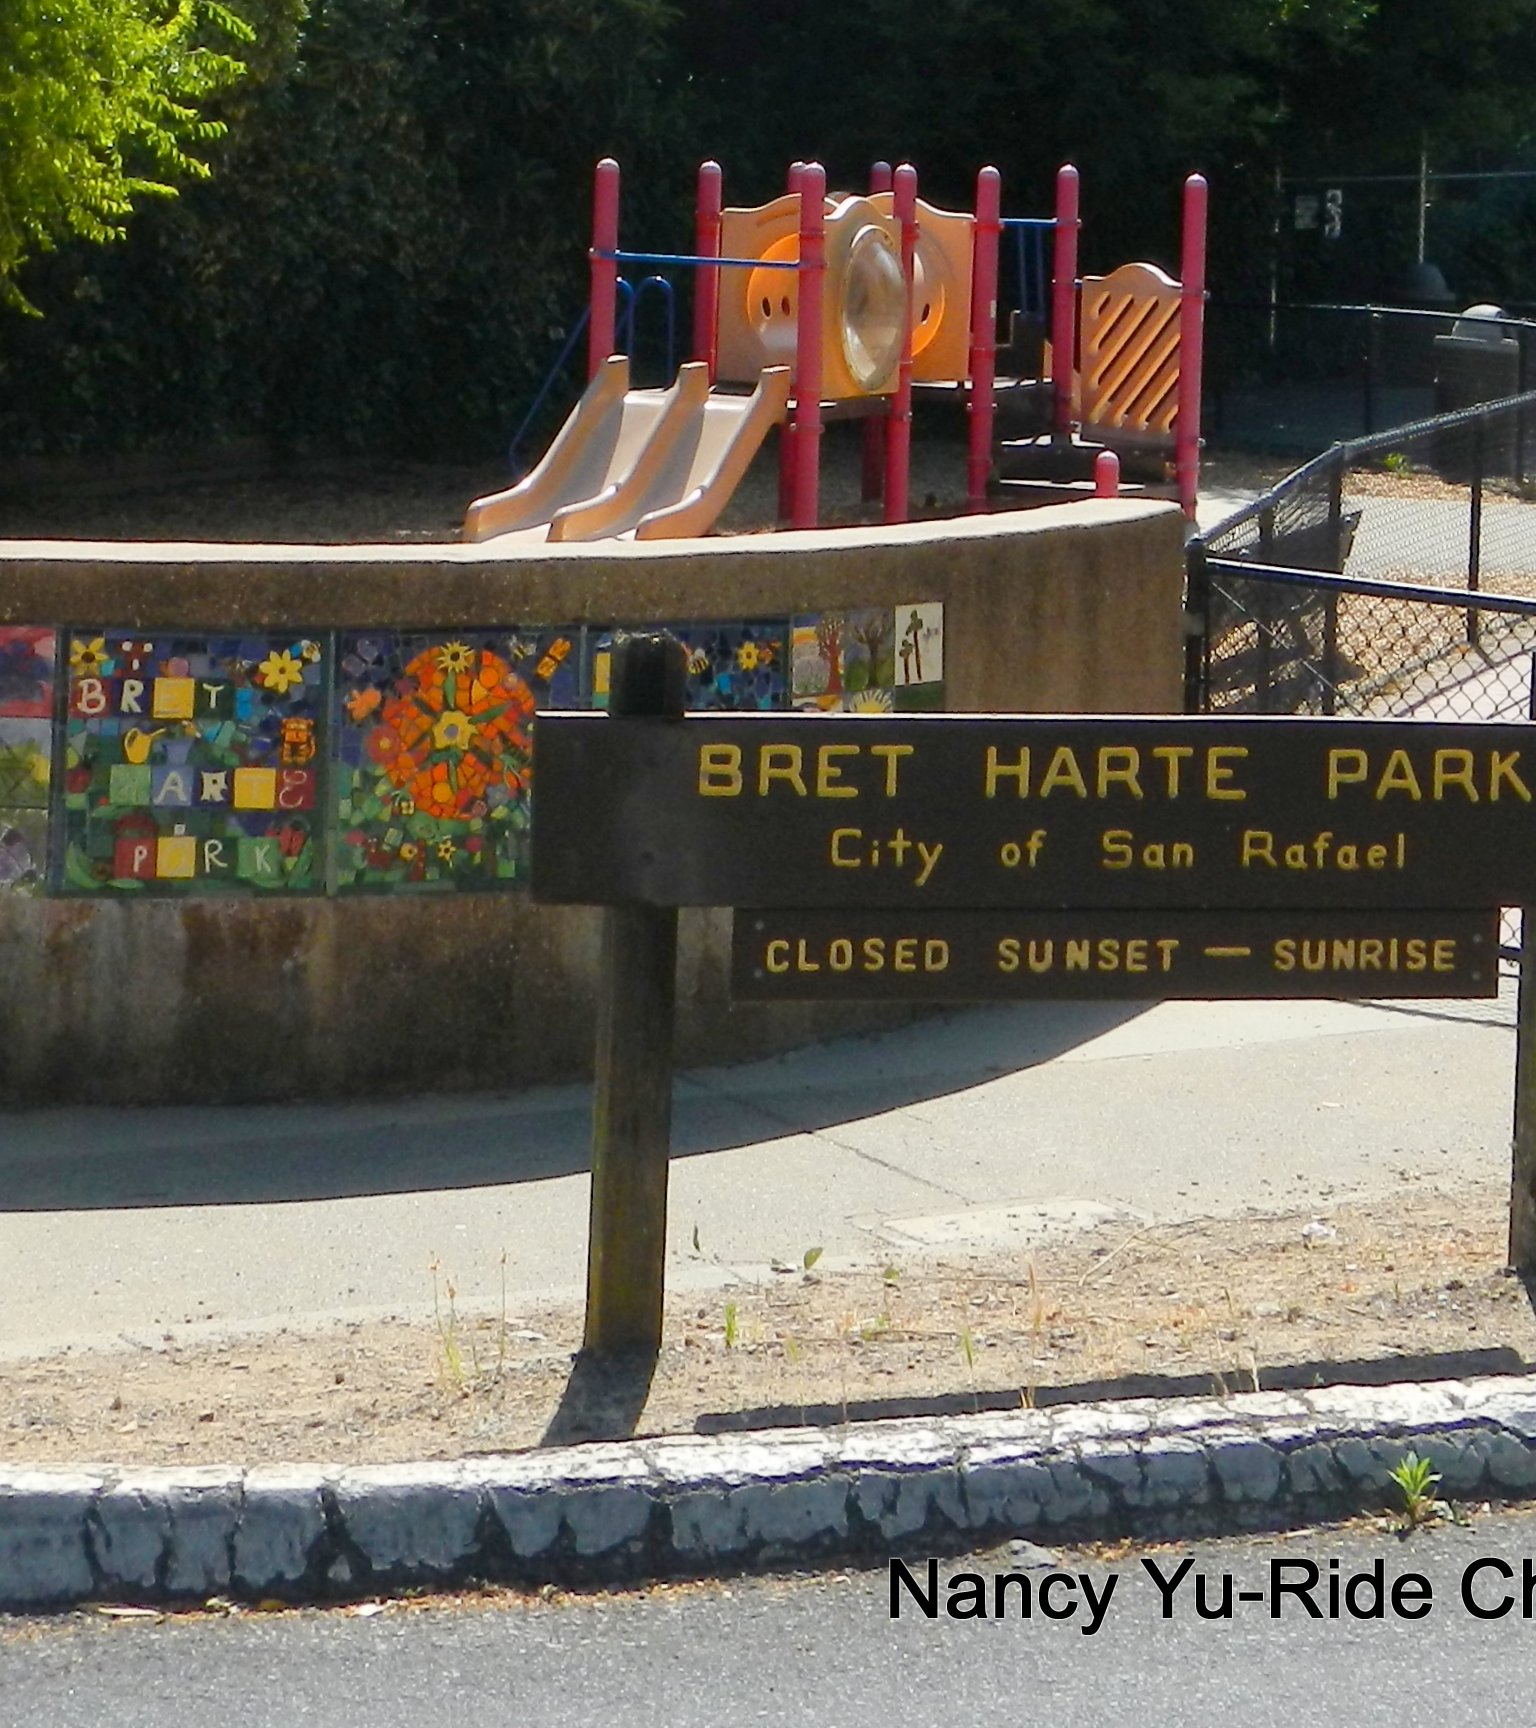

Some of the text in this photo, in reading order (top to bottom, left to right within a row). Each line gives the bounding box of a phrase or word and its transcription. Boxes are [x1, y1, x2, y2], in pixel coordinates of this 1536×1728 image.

[74, 677, 225, 716] BRET
[112, 765, 306, 809] ARTE
[697, 742, 1533, 803] BRET HARTE PARK
[830, 827, 1406, 886] City of San Rafael
[765, 936, 950, 974] CLOSED
[997, 937, 1180, 973] SUNSET
[1273, 937, 1457, 972] SUNRISE
